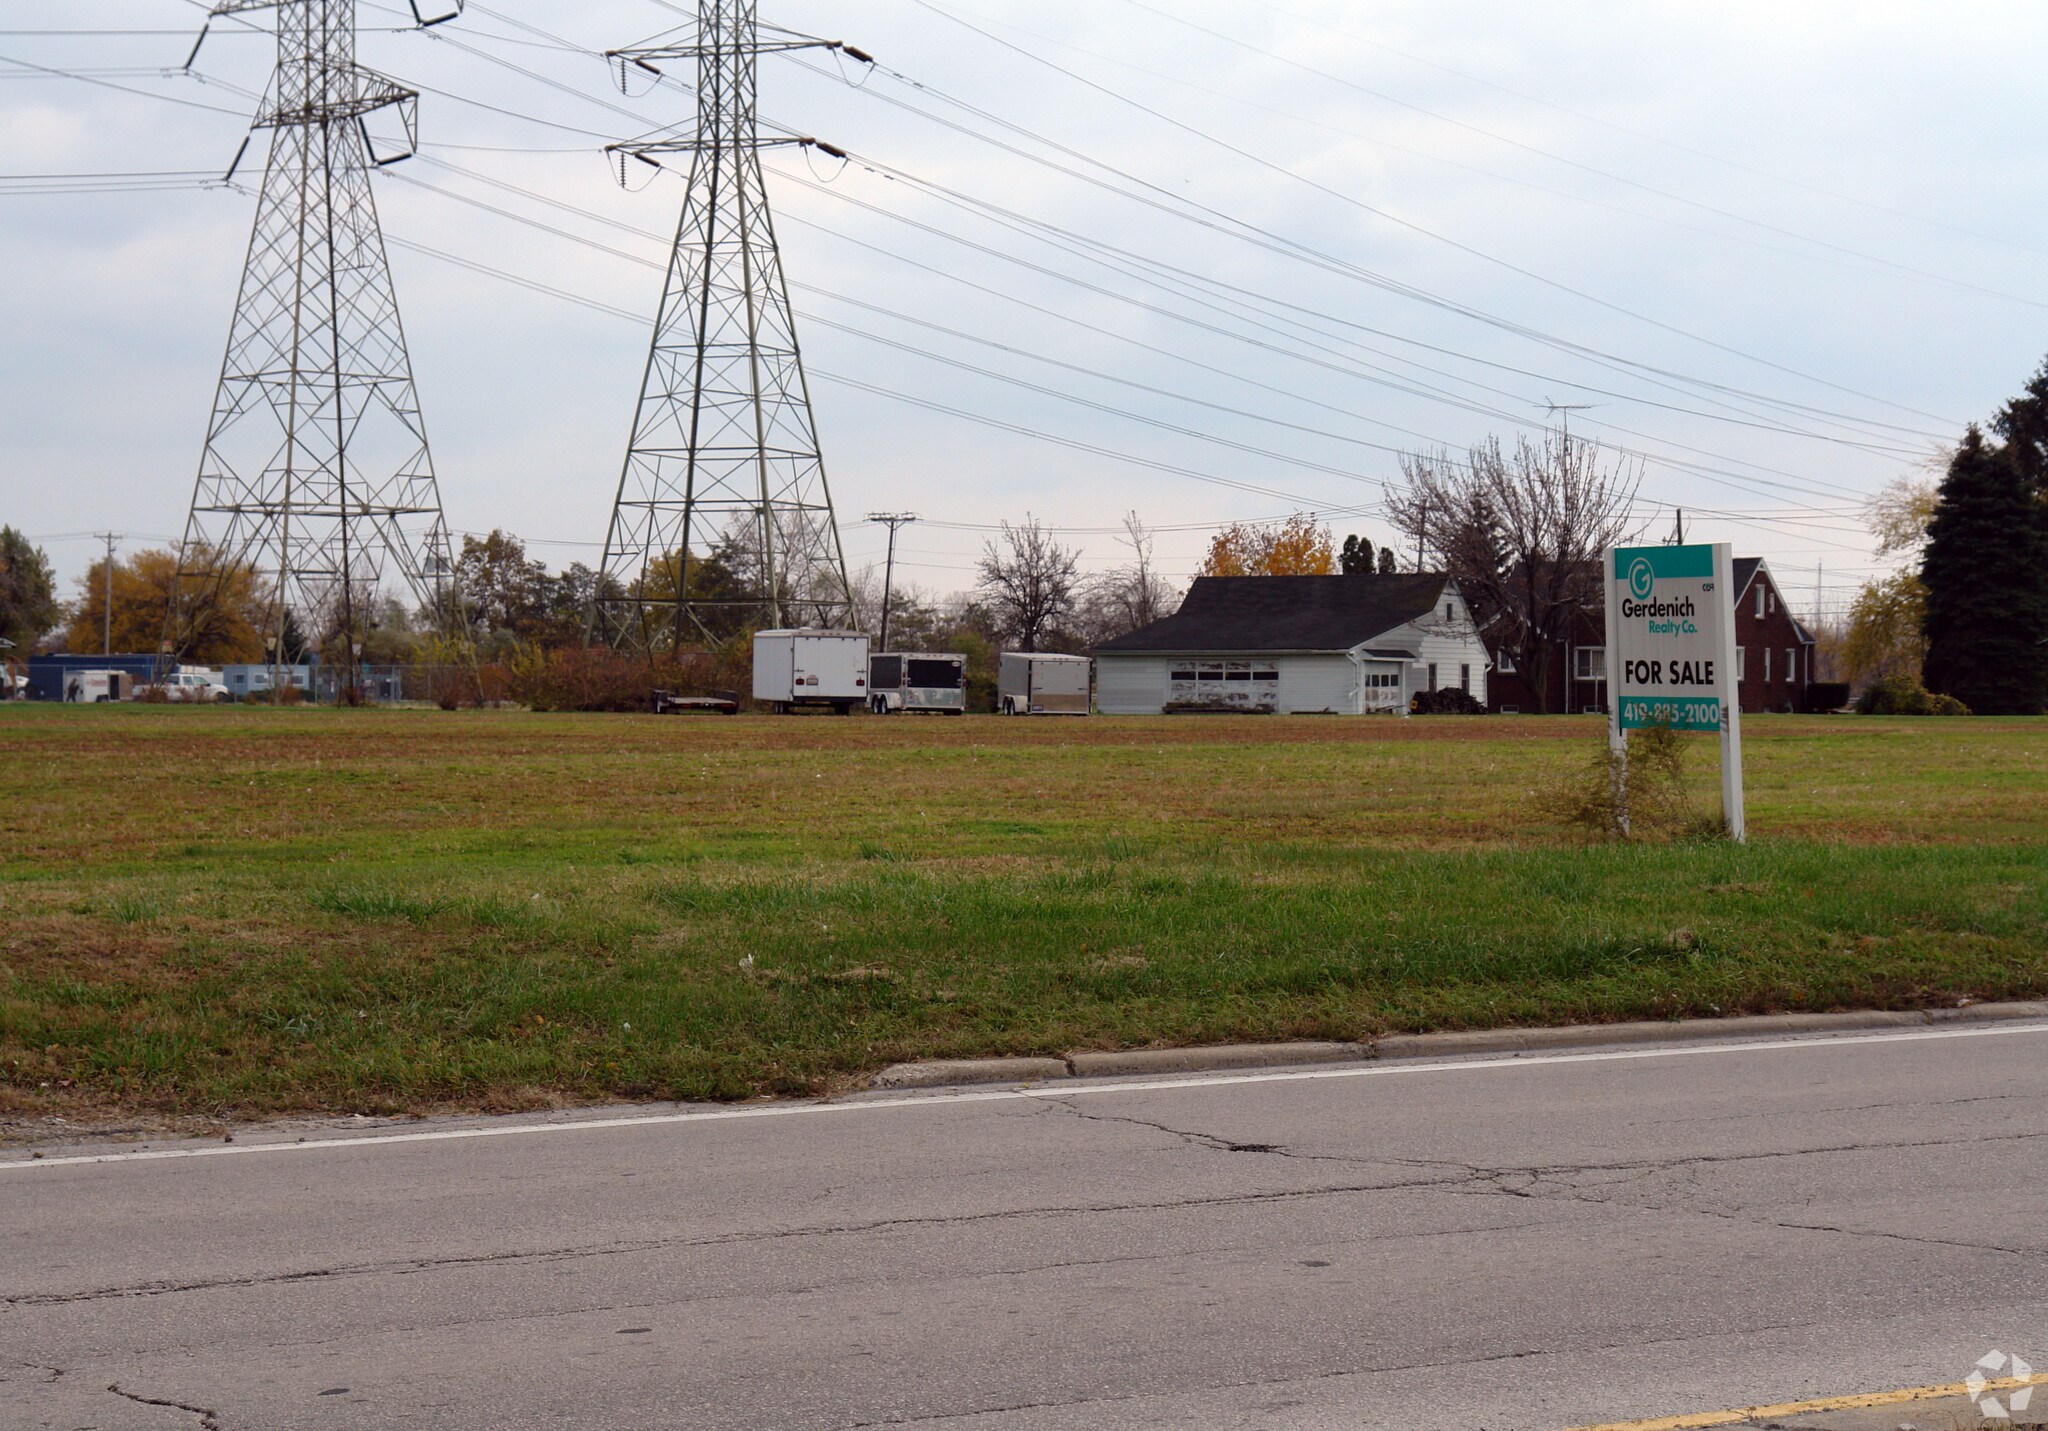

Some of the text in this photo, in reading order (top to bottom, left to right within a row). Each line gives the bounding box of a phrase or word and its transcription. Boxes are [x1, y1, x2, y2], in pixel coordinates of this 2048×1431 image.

[1622, 596, 1695, 618] Gerdenich
[1649, 619, 1697, 637] Realty Co.
[1625, 660, 1714, 685] FOR SALE
